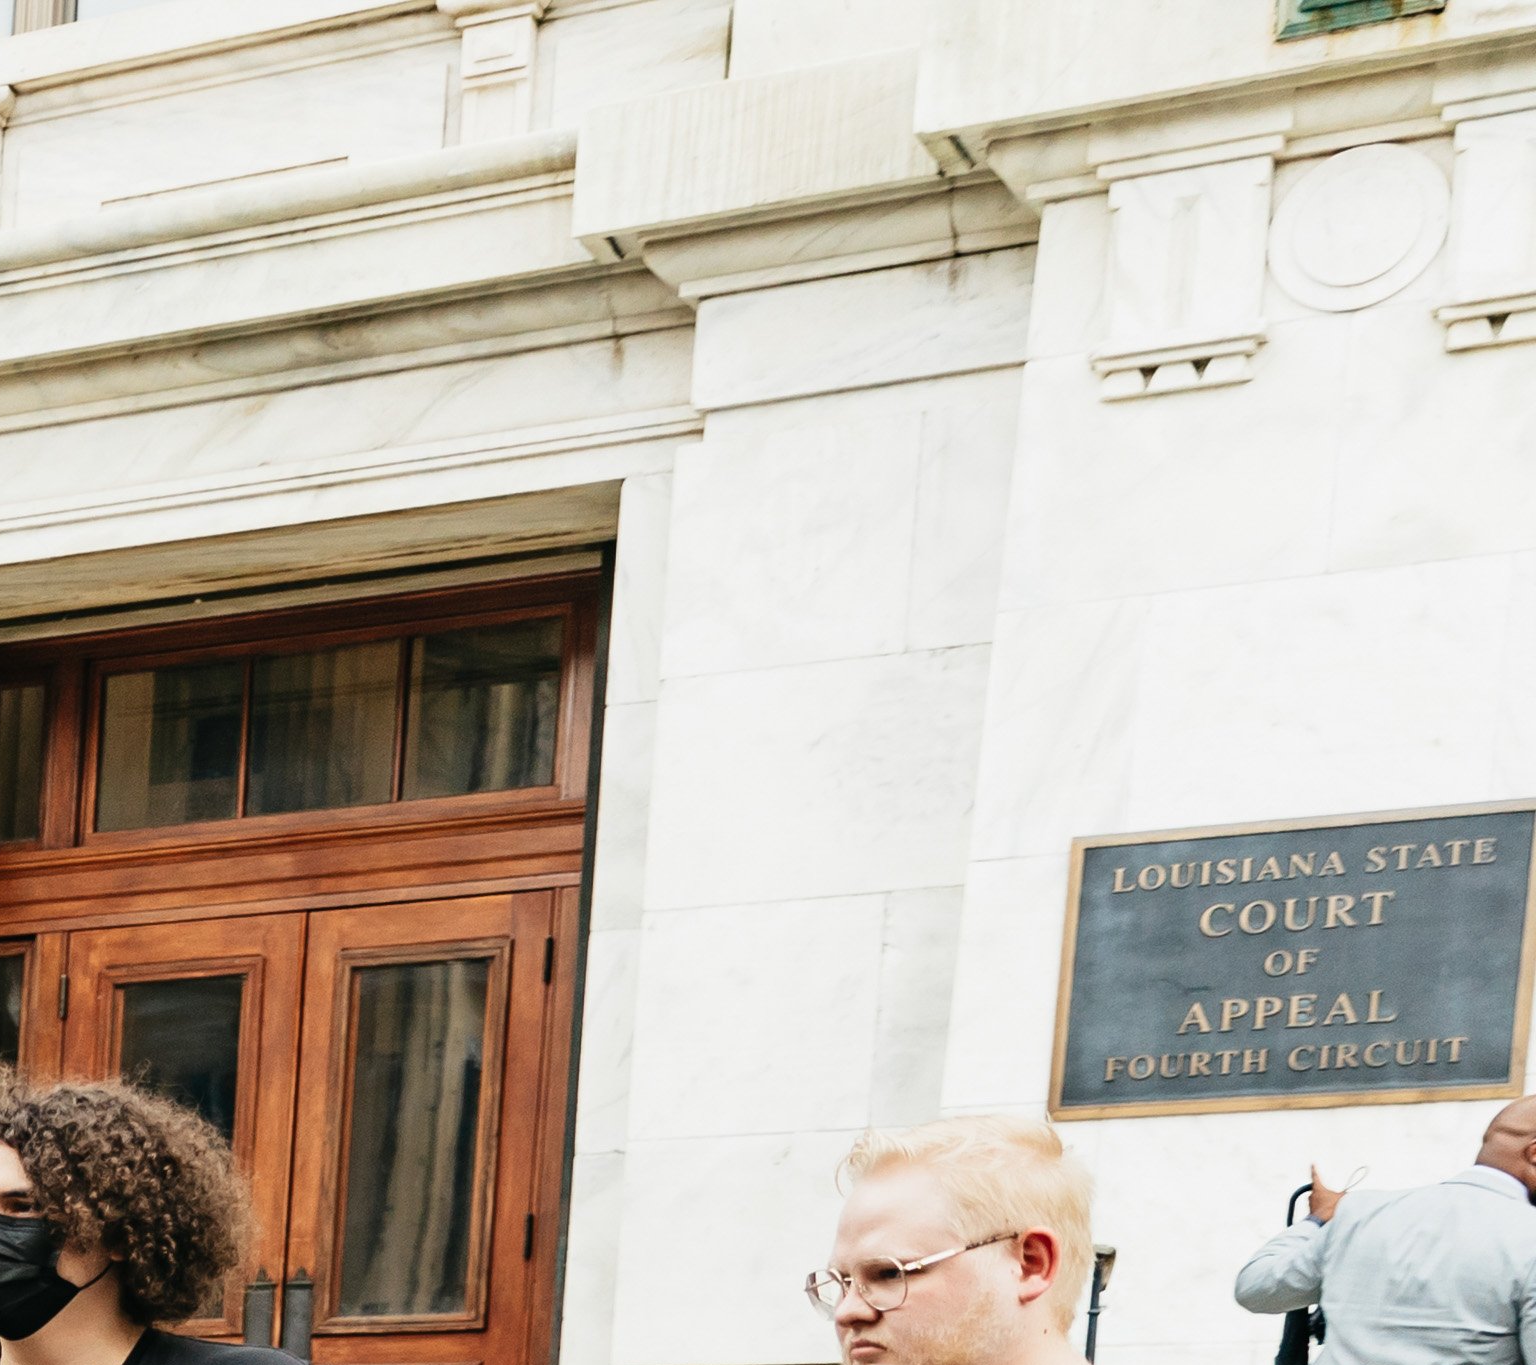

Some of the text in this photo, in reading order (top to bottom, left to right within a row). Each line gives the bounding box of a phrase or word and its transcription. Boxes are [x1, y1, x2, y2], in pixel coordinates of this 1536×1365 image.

[1111, 837, 1498, 894] LOUISIANA STATE
[1198, 891, 1396, 937] COURT
[1263, 948, 1321, 977] OF
[1177, 990, 1399, 1035] APPEAL
[1103, 1036, 1469, 1083] FOURTH CIRCUIT
